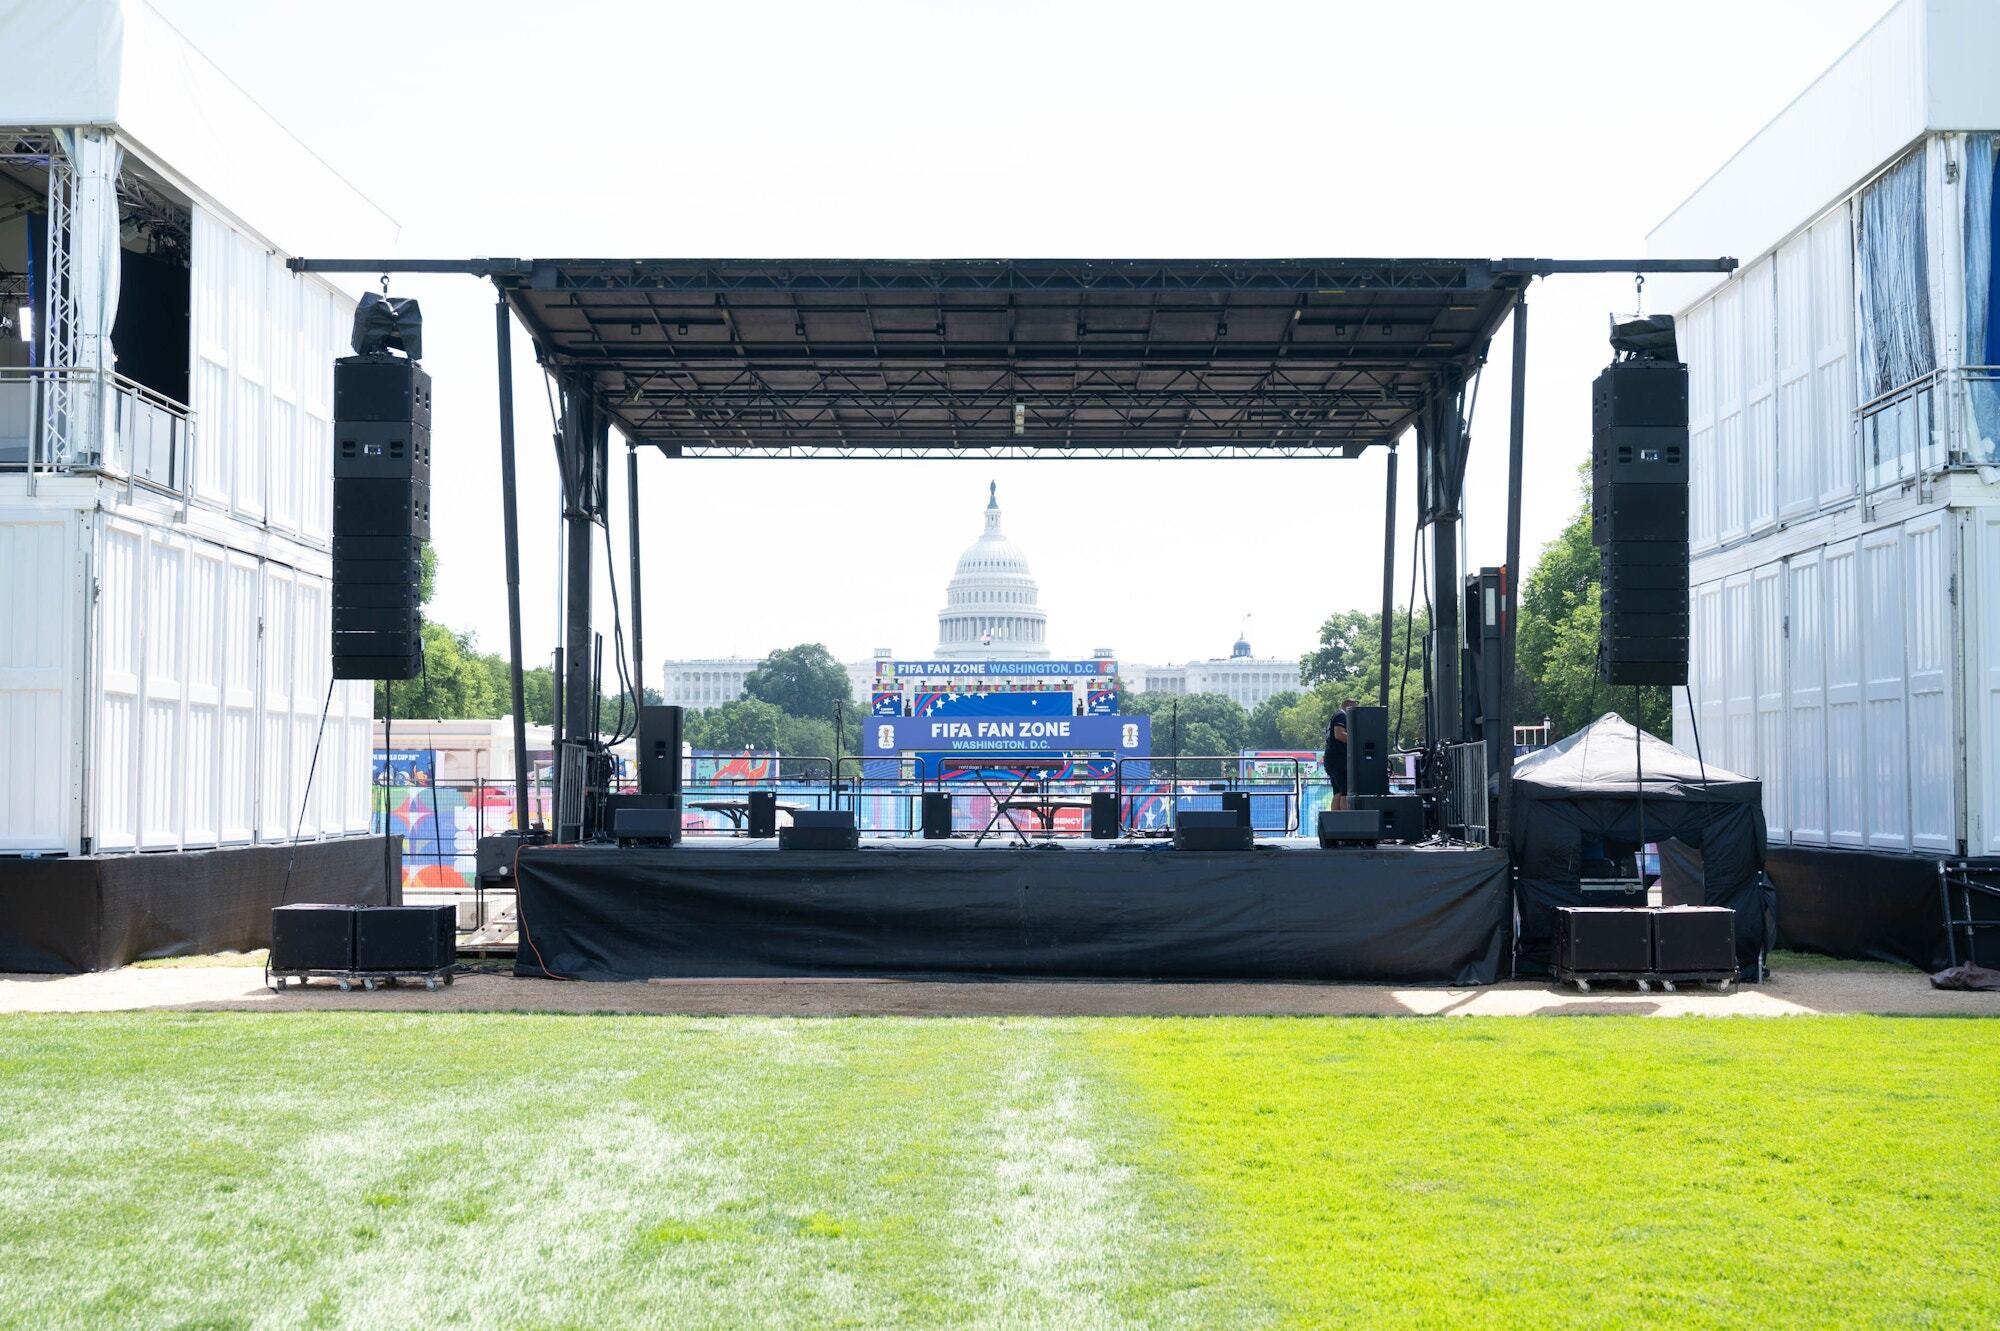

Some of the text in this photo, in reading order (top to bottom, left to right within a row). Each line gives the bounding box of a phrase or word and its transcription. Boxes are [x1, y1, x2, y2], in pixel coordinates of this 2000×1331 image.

[898, 663, 1096, 675] FIFA FAN ZONE WASHINGTON, D.C.
[931, 722, 1071, 738] FIFA FAN ZONE
[1030, 740, 1051, 749] D.C.
